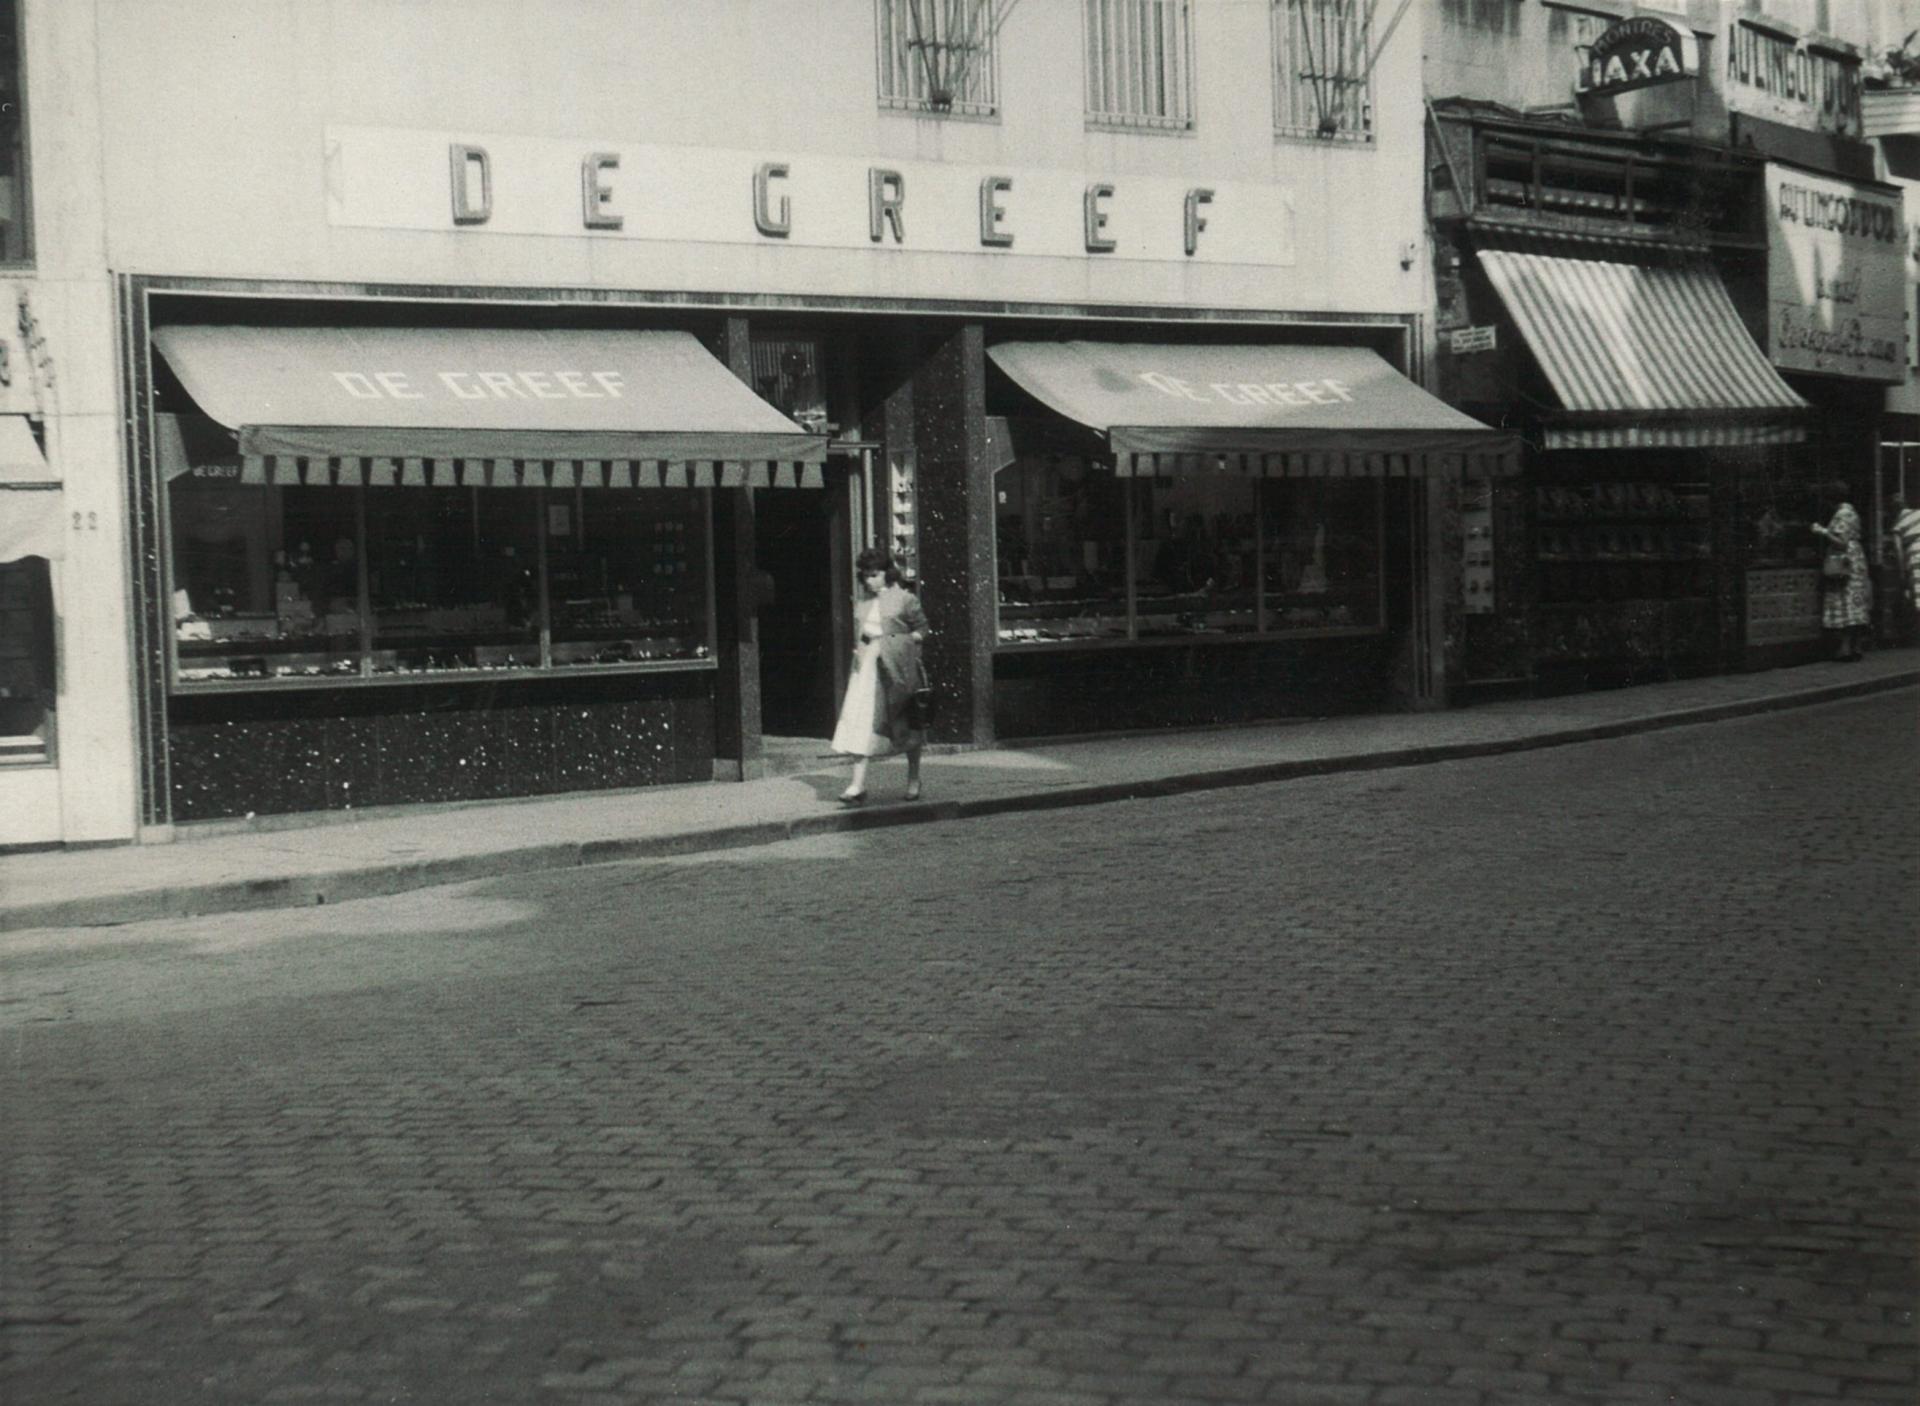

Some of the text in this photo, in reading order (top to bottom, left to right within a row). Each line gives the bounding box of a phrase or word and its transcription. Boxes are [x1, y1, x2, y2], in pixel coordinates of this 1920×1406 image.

[449, 143, 1216, 257] DE GREEF
[331, 371, 624, 399] DE GREEF
[1138, 371, 1353, 405] DE GREEF
